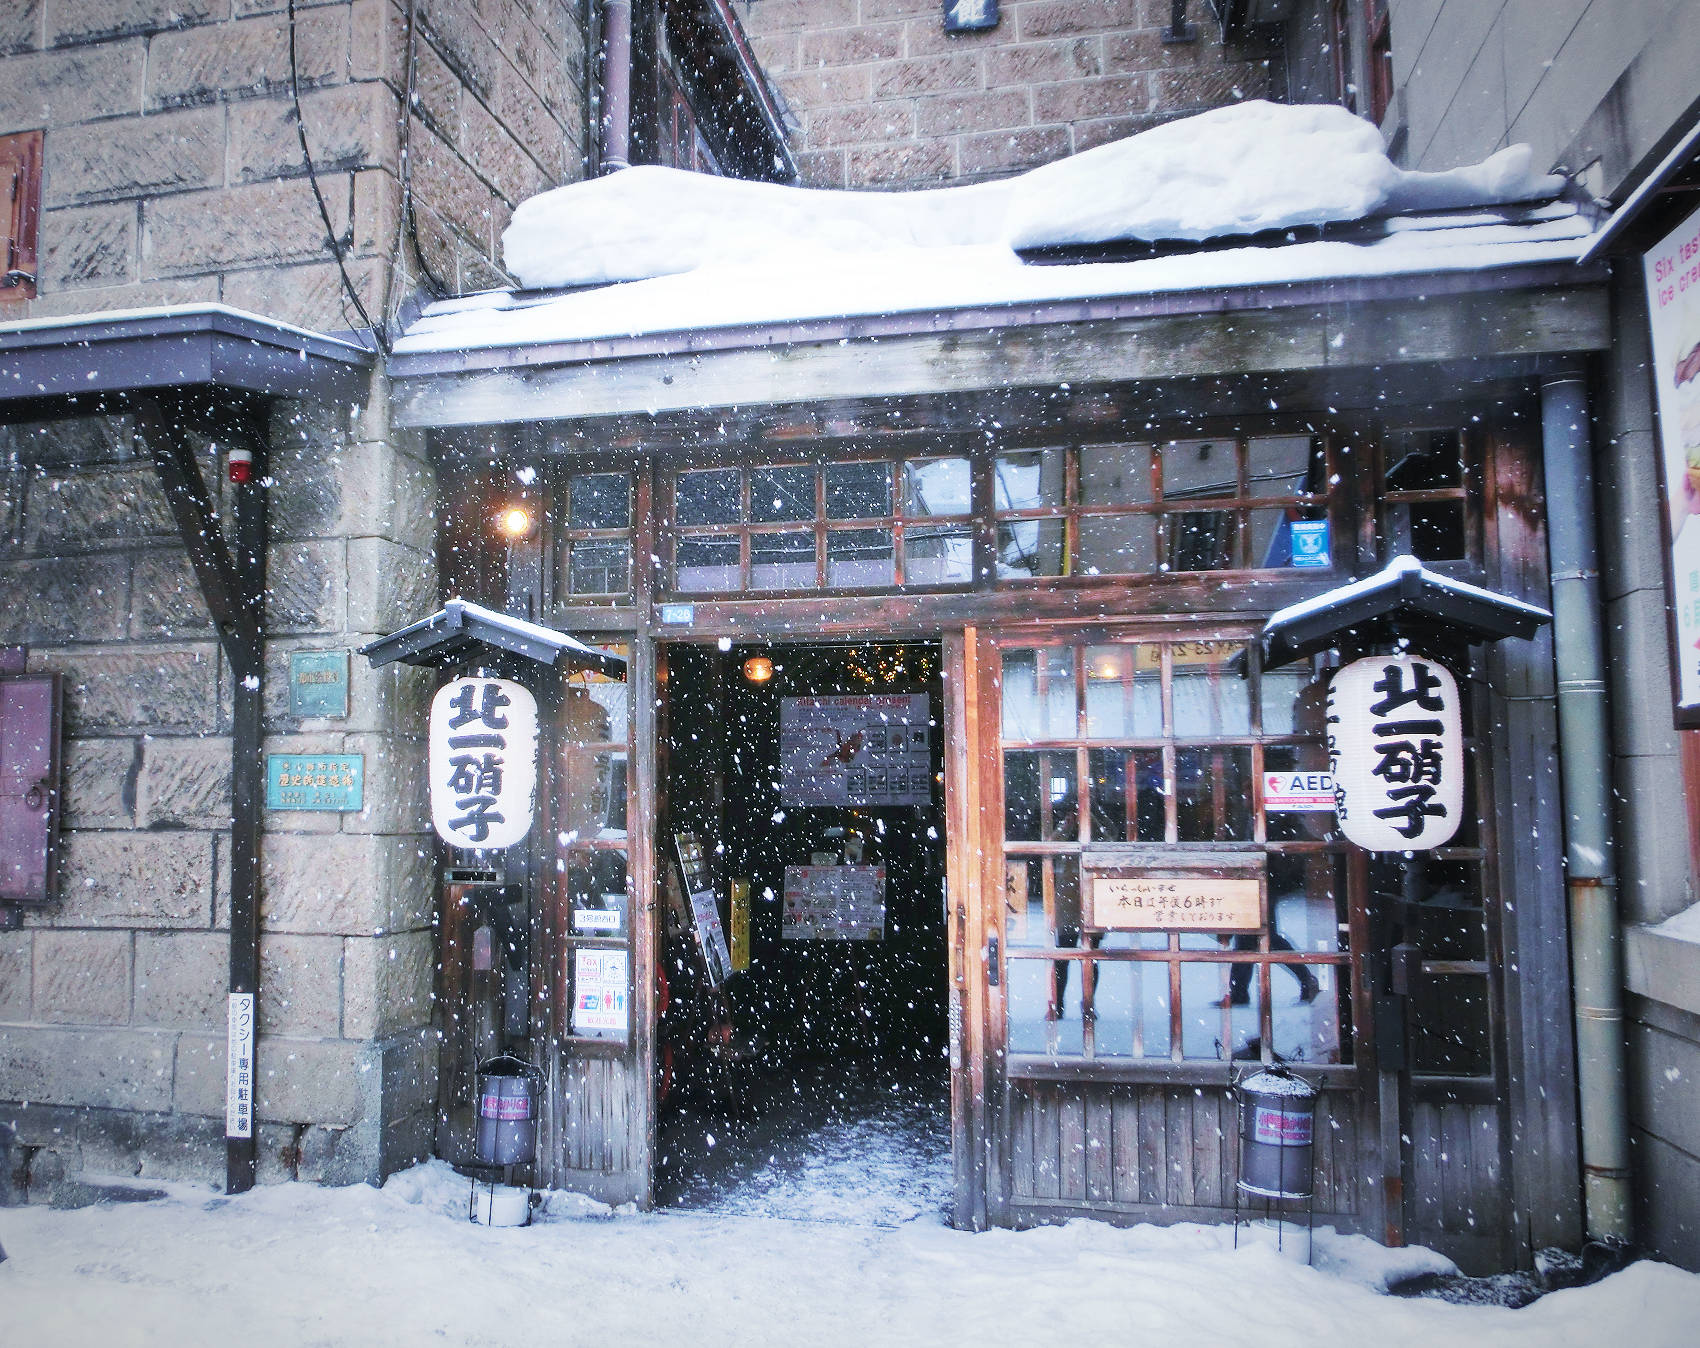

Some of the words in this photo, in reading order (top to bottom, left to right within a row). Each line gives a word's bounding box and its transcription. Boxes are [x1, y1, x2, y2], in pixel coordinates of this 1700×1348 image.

[1655, 255, 1674, 282] Six
[1679, 230, 1700, 264] tas
[447, 683, 511, 842] 北一硝子
[1290, 775, 1333, 791] AED
[1370, 663, 1447, 839] 北一硝子
[238, 998, 251, 1132] タクシー専用駐車場
